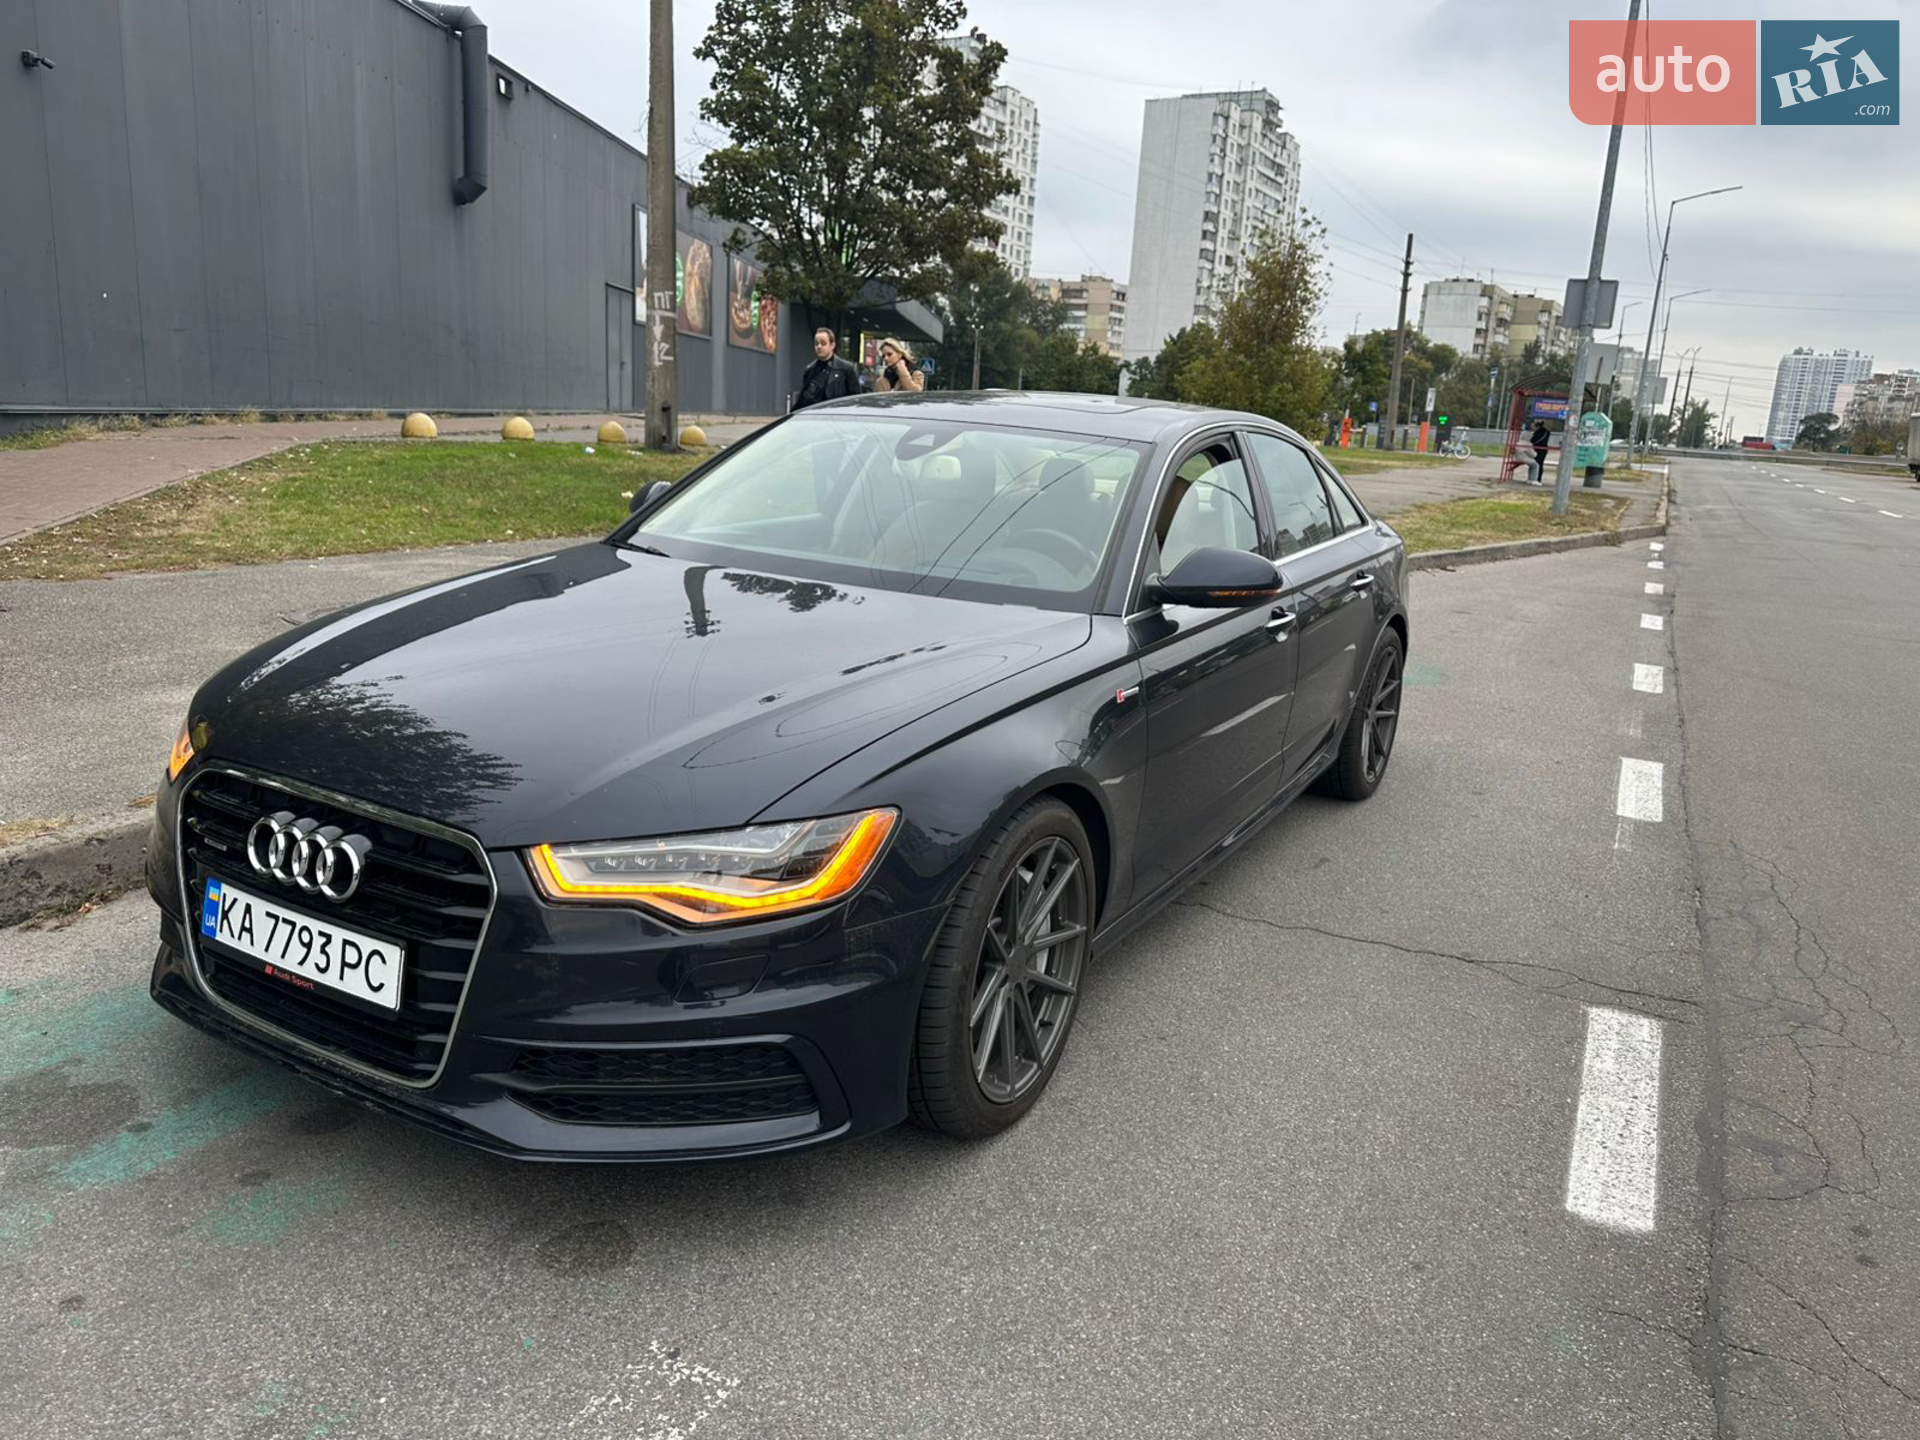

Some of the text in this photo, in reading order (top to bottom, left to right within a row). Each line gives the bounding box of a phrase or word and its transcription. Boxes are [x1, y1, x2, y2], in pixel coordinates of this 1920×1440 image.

[205, 912, 216, 928] UA
[219, 892, 387, 993] KA 7793 PC
[273, 968, 315, 990] Audi Sport
